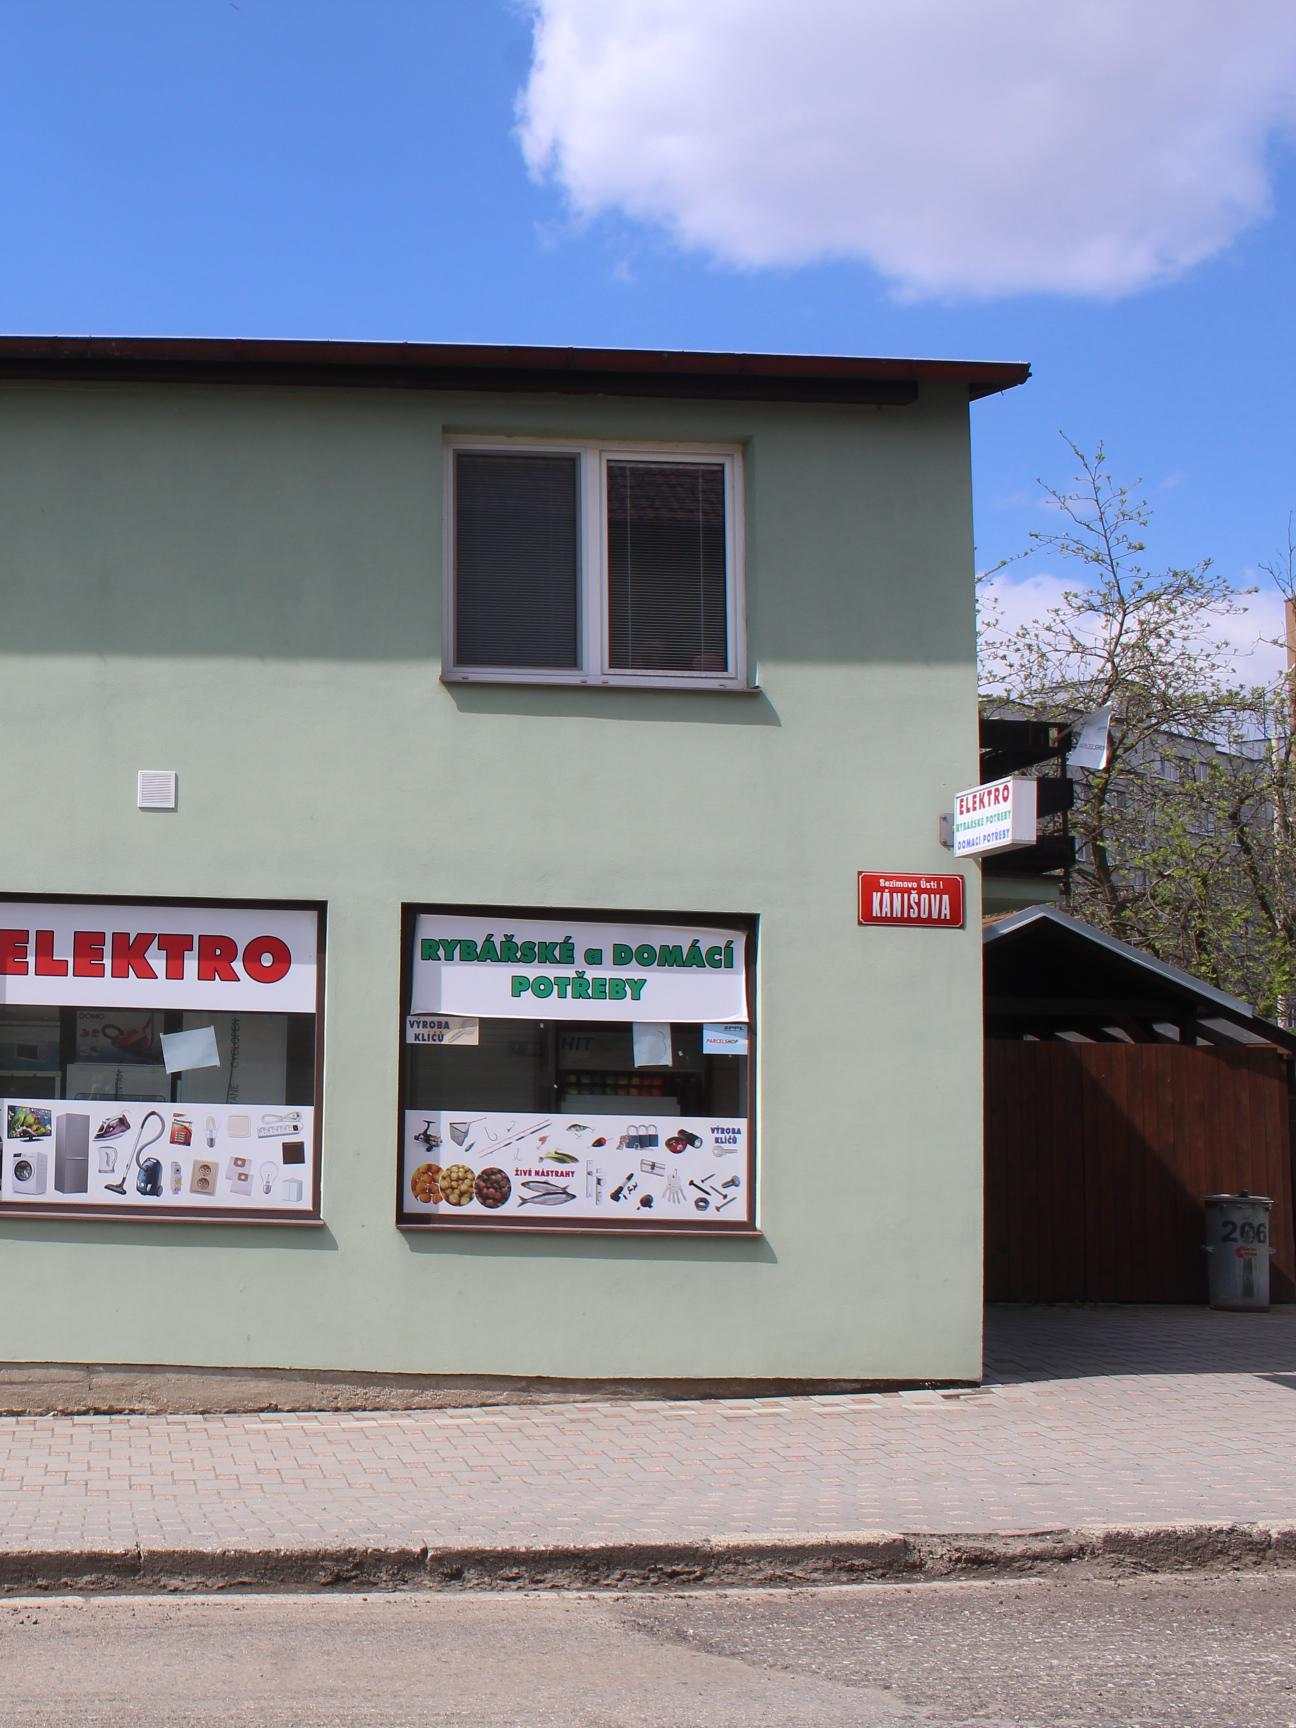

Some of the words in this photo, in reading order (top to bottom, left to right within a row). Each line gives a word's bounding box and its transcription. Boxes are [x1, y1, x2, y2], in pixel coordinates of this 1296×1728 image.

[959, 784, 1010, 815] ELEKTRO
[879, 878, 918, 888] Sezimovo
[872, 888, 950, 920] KÁNIŠOVA
[421, 934, 575, 965] RYBÁŘSKÉ
[584, 948, 603, 965] a
[612, 940, 734, 969] DOMÁCÍ
[511, 971, 647, 1000] POTŘEBY
[409, 1018, 450, 1030] VÝROBA
[414, 1031, 444, 1042] KLÍČŮ
[711, 1125, 742, 1135] VÝROBA
[715, 1135, 737, 1144] KLÍČŮ
[515, 1168, 532, 1176] ŽIVÉ
[534, 1168, 576, 1177] NÁSTRAHY
